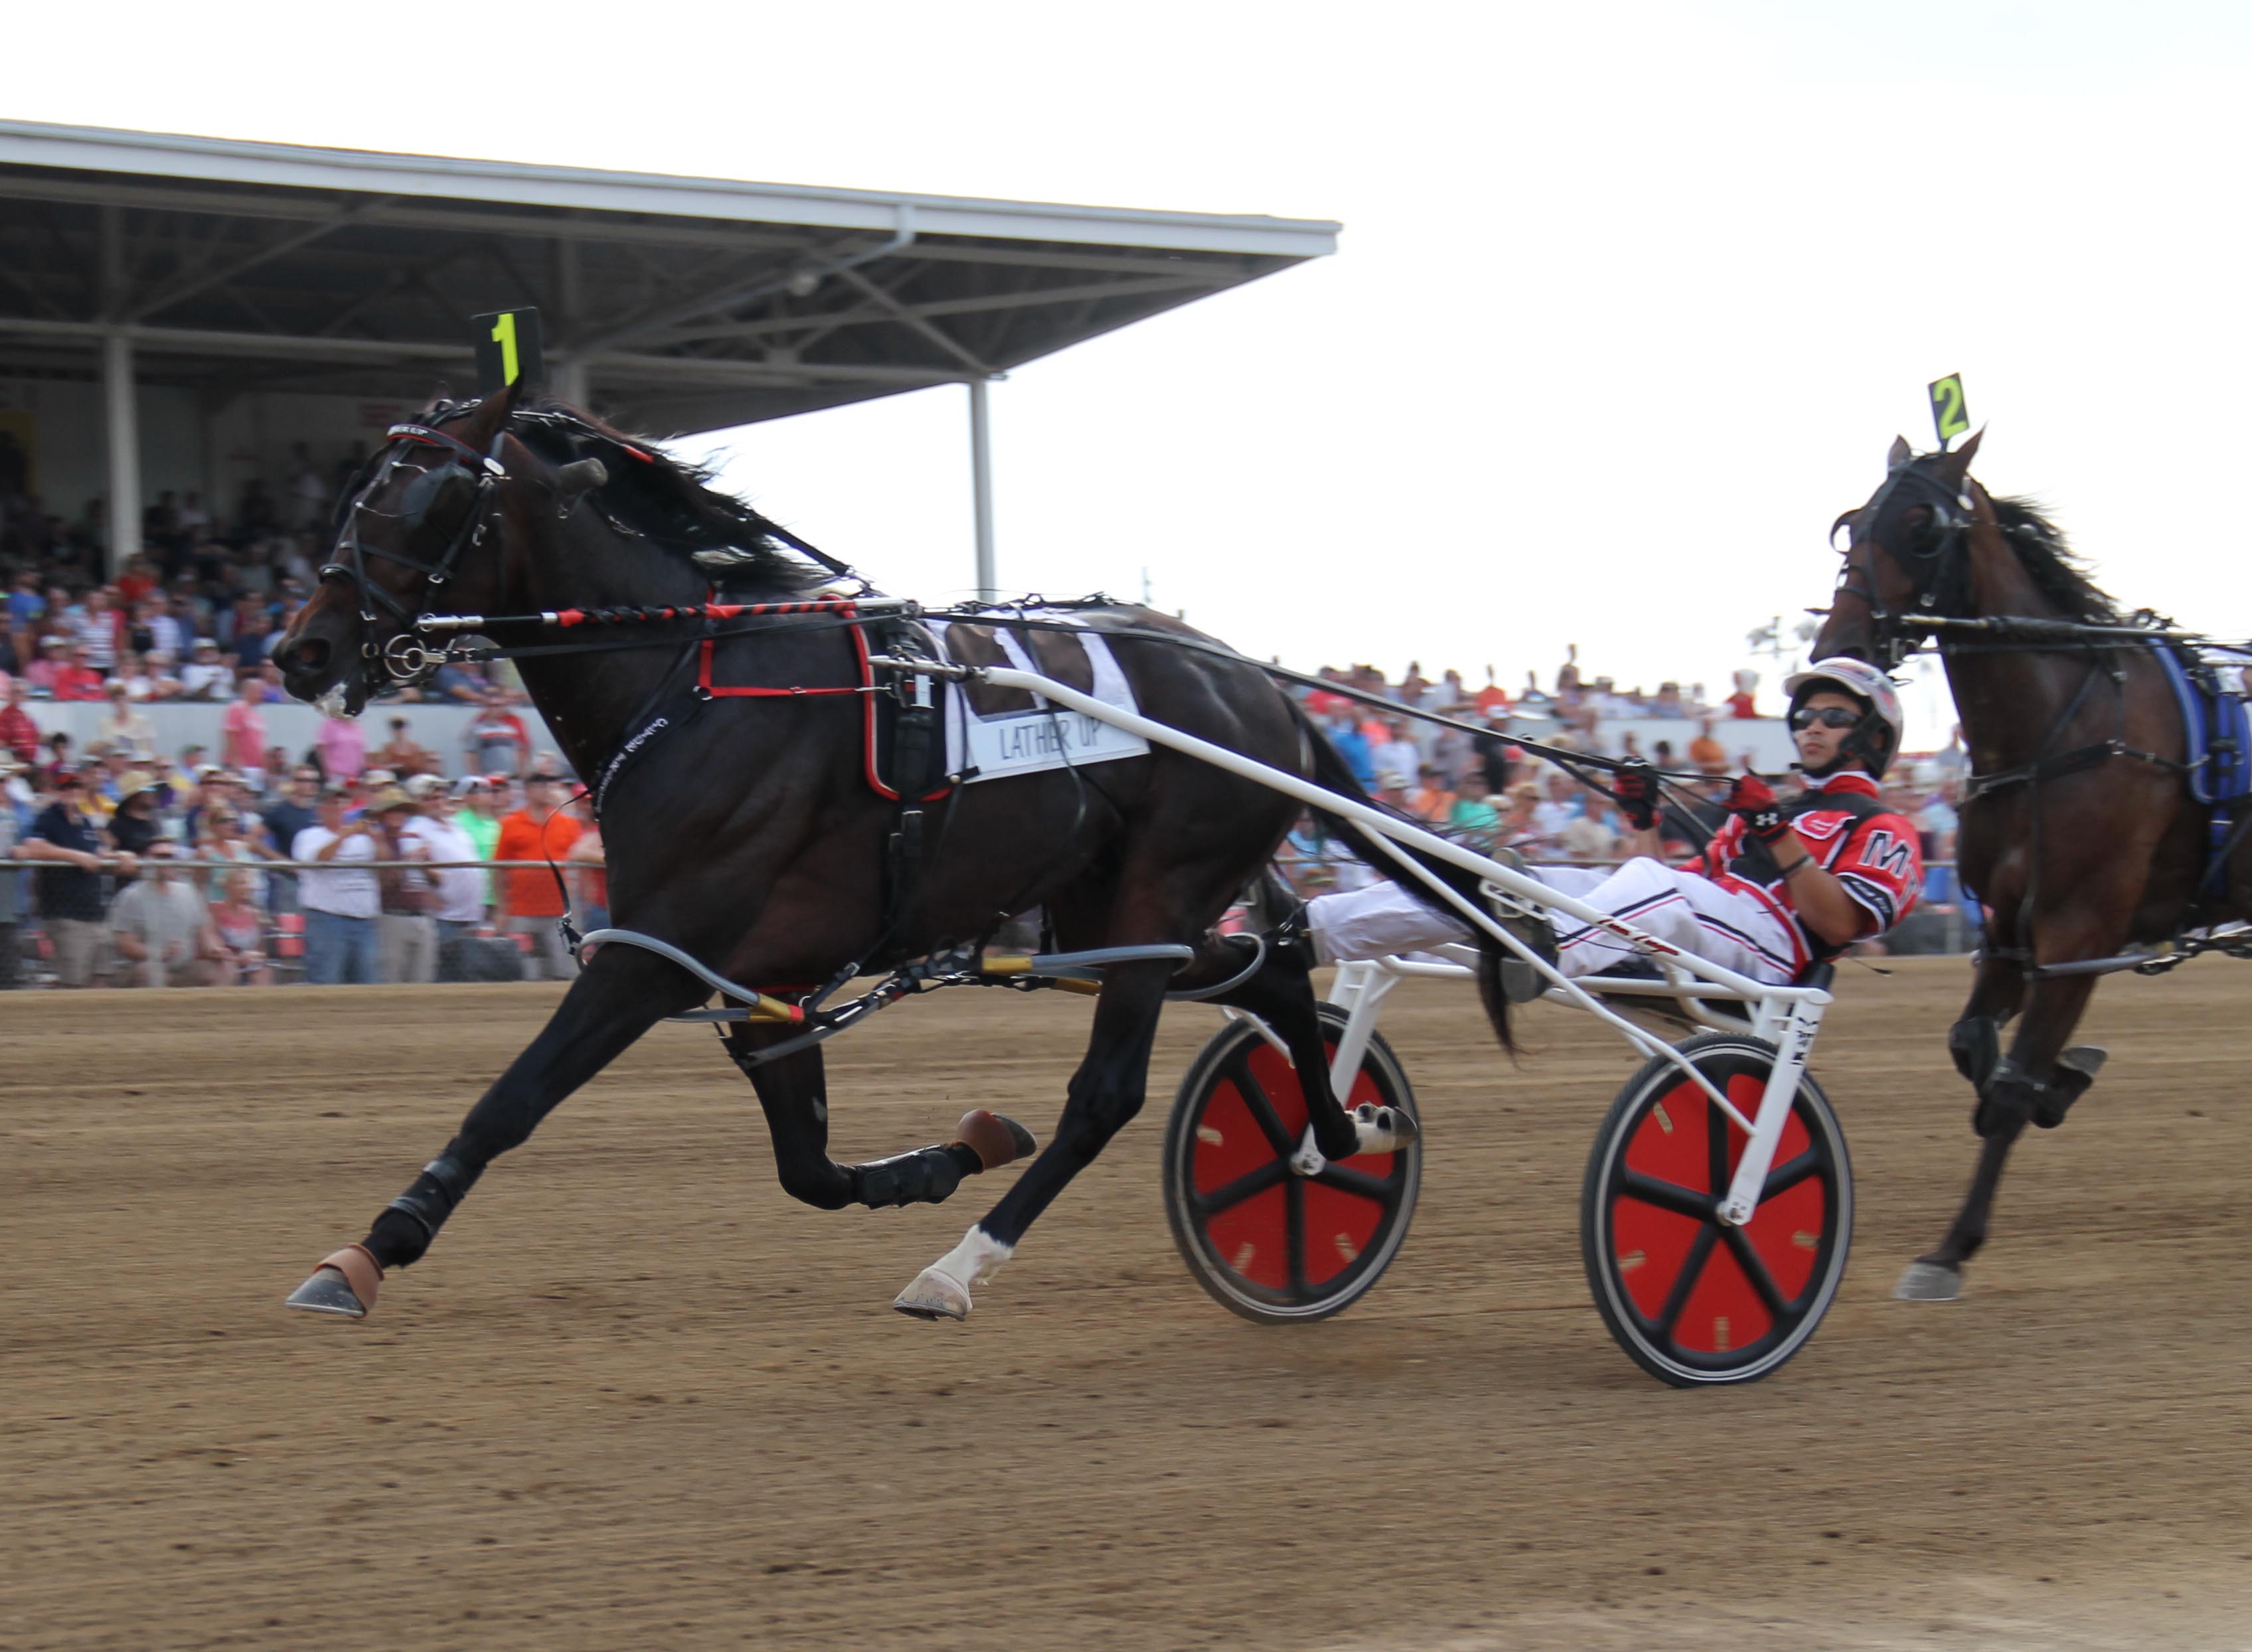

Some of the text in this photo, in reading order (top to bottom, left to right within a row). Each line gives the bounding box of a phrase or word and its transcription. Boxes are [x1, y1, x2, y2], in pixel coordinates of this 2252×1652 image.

[491, 313, 519, 386] 1
[1933, 378, 1967, 439] 2
[999, 716, 1102, 760] LATHER UP
